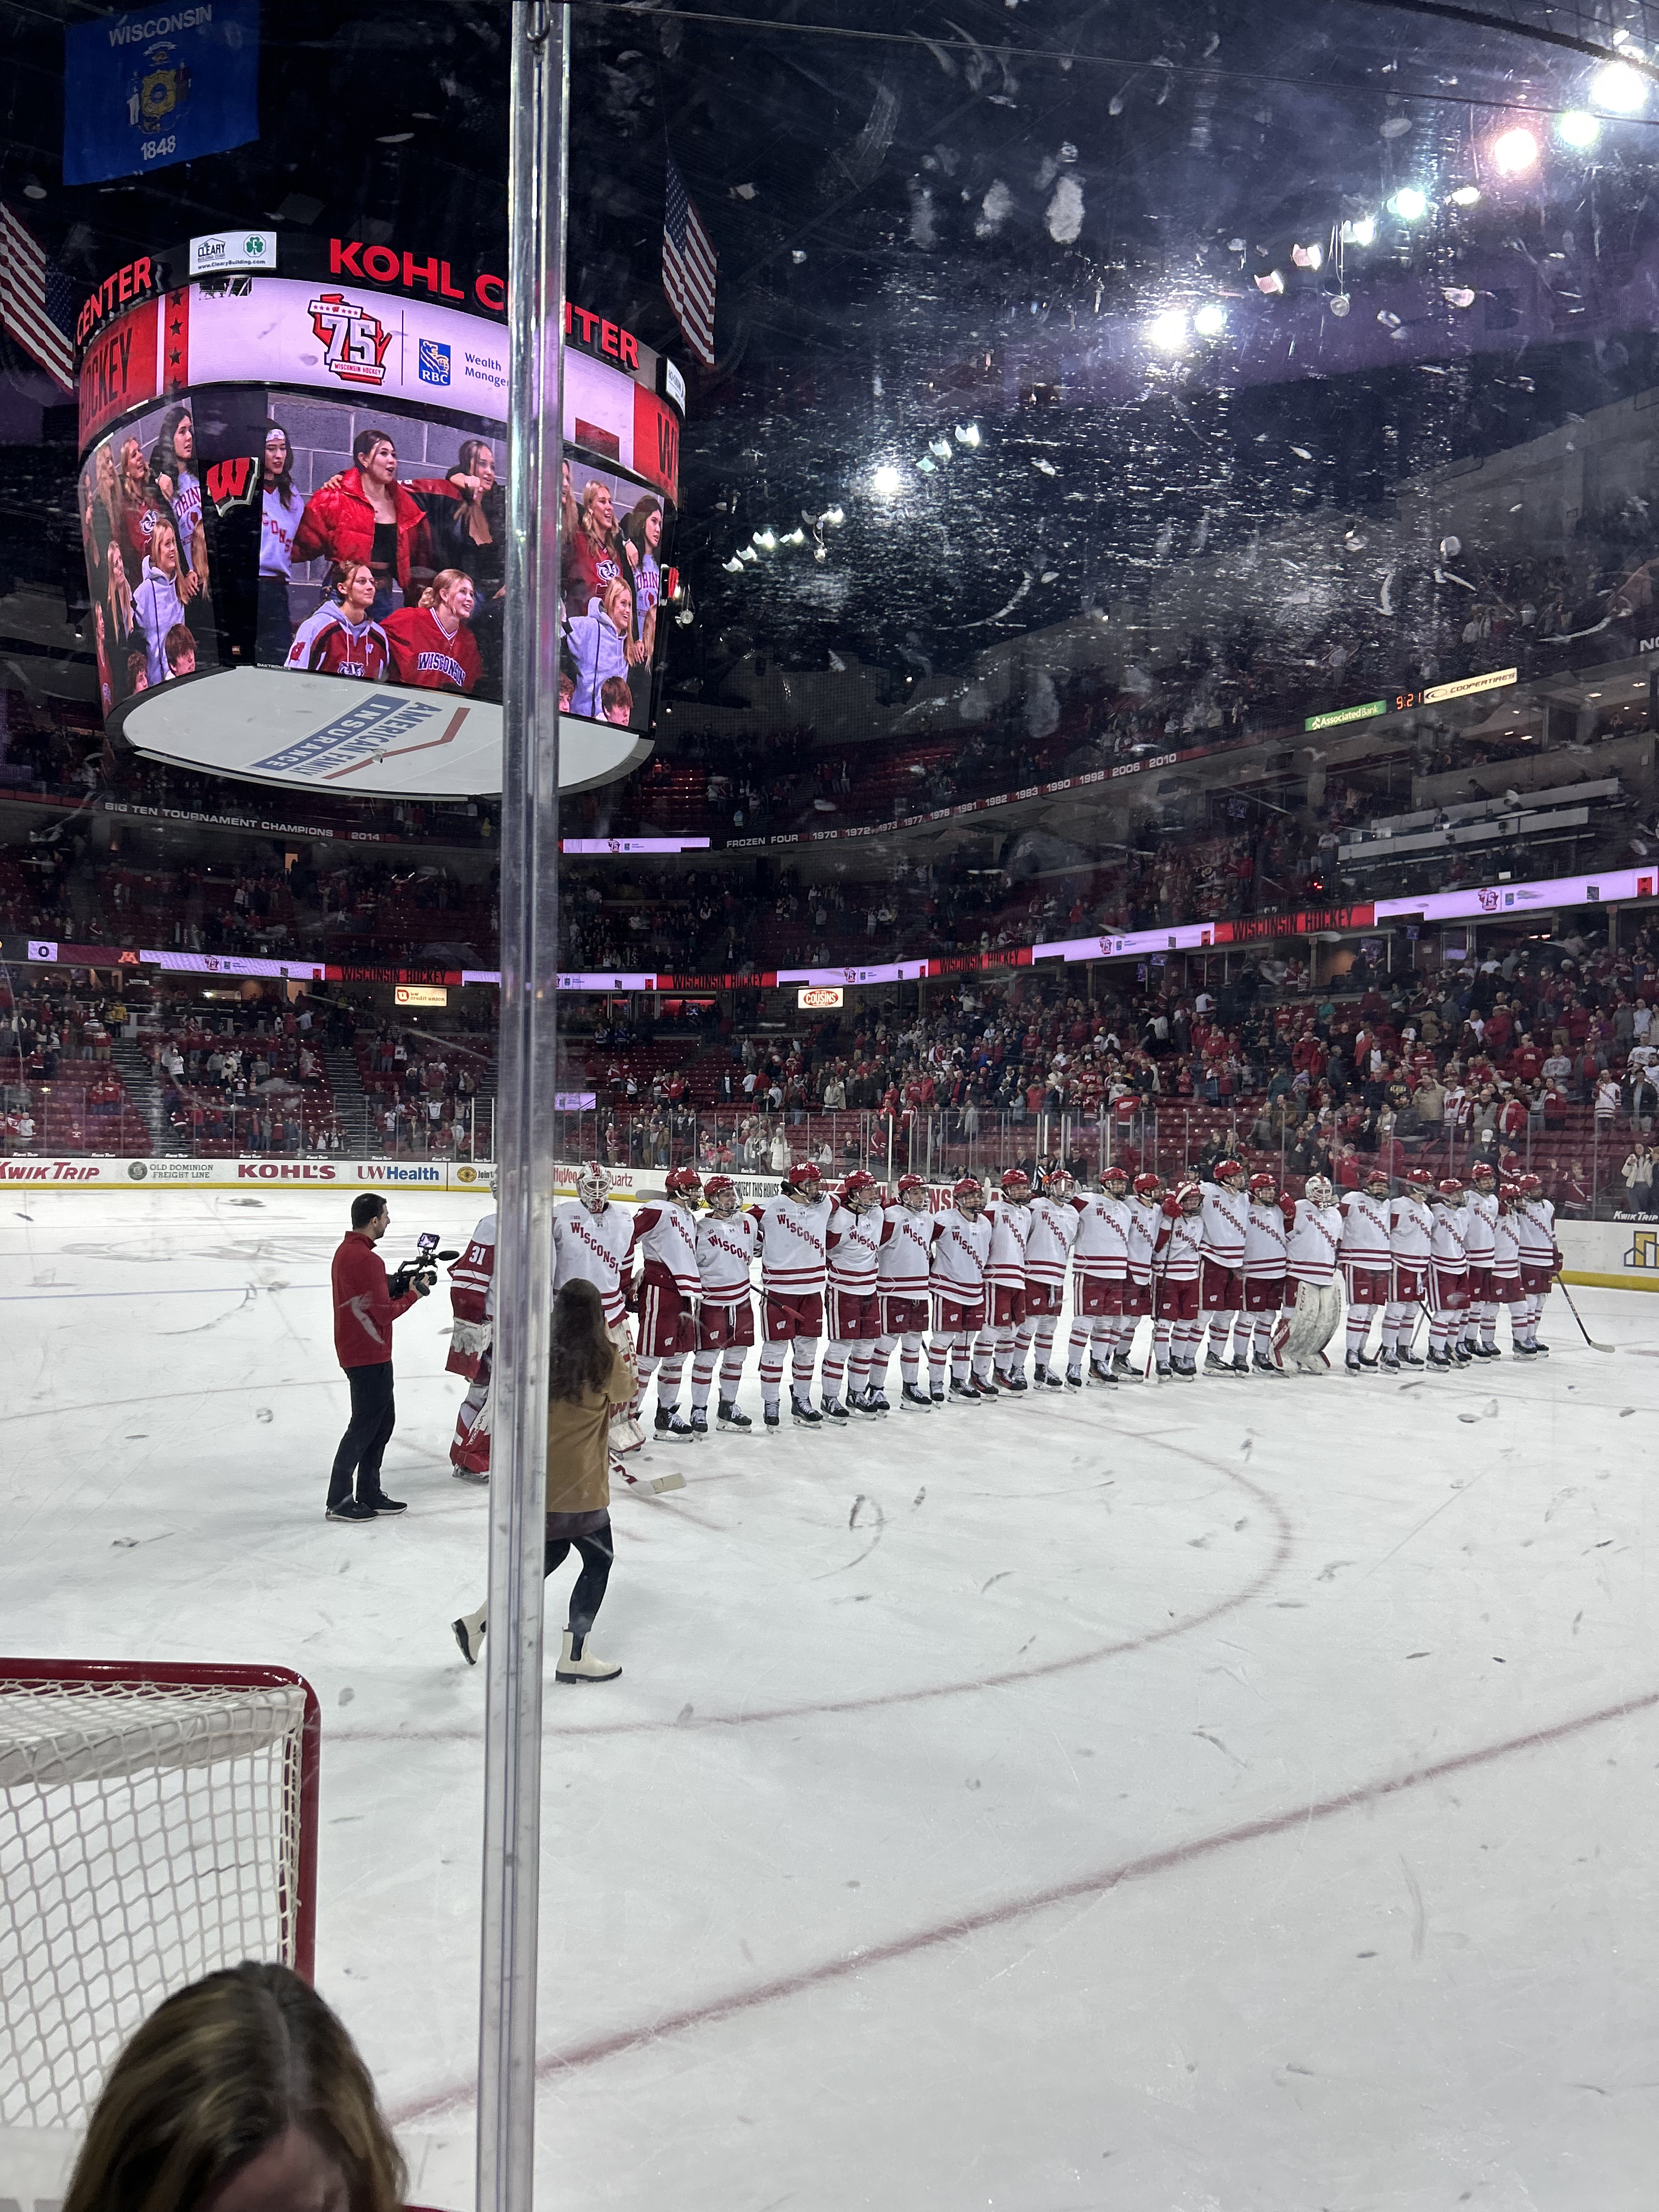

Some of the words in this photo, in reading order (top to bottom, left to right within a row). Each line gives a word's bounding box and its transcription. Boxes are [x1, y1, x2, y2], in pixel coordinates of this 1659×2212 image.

[109, 4, 212, 47] WISCONSIN
[140, 135, 176, 160] 1848
[198, 243, 225, 257] CLEARY
[198, 259, 266, 269] www.ClearyBuilding.com
[77, 256, 151, 346] CENTER
[330, 238, 464, 300] KOHL
[475, 274, 639, 369] CTER
[322, 314, 376, 365] 75
[334, 363, 360, 372] WISCONSIN
[363, 367, 381, 375] HOCKEY
[465, 352, 501, 371] Wealth
[422, 369, 448, 384] RBC
[465, 366, 509, 387] Manage
[417, 652, 466, 686] WISCONSIN
[1450, 673, 1516, 693] COOPERTIRES
[266, 703, 392, 768] INSURANCE
[338, 702, 442, 755] AMERICAN
[287, 752, 357, 776] FAMILY
[726, 837, 766, 848] FROZEN
[771, 834, 799, 844] FOUR
[812, 830, 837, 840] 1970
[845, 827, 871, 837] 1972
[878, 821, 898, 832] 1973
[904, 815, 923, 827] 1977
[930, 809, 950, 820] 1978
[957, 802, 977, 813] 1981
[985, 794, 1007, 807] 1982
[1015, 787, 1039, 800] 1983
[1046, 779, 1070, 792] 1990
[1079, 771, 1104, 784] 1992
[1112, 763, 1141, 776] 2006
[1149, 753, 1177, 768] 2010
[105, 802, 127, 812] BIG
[132, 805, 158, 816] TEN
[162, 808, 258, 828] TOURNAMENT
[261, 821, 334, 837] CHAMPIONS
[351, 831, 380, 842] 2014
[1232, 914, 1298, 941] WISCONSIN
[1305, 907, 1354, 930] HOCKEY
[940, 954, 983, 974] WISCONSIN
[988, 950, 1019, 968] HOCKEY
[342, 966, 399, 983] WISCONSIN
[406, 969, 445, 985] HOCKEY
[673, 973, 725, 988] WISCONSIN
[731, 973, 763, 988] HOCKEY
[806, 992, 836, 1004] COUSINS
[53, 1162, 100, 1180] TRIP
[239, 1164, 336, 1180] KOHL'S
[752, 1182, 763, 1197] THIS
[763, 1183, 780, 1198] HOUSE
[591, 1200, 602, 1212] 34
[742, 1220, 751, 1234] A
[469, 1245, 486, 1265] 31
[625, 1330, 638, 1365] CCM
